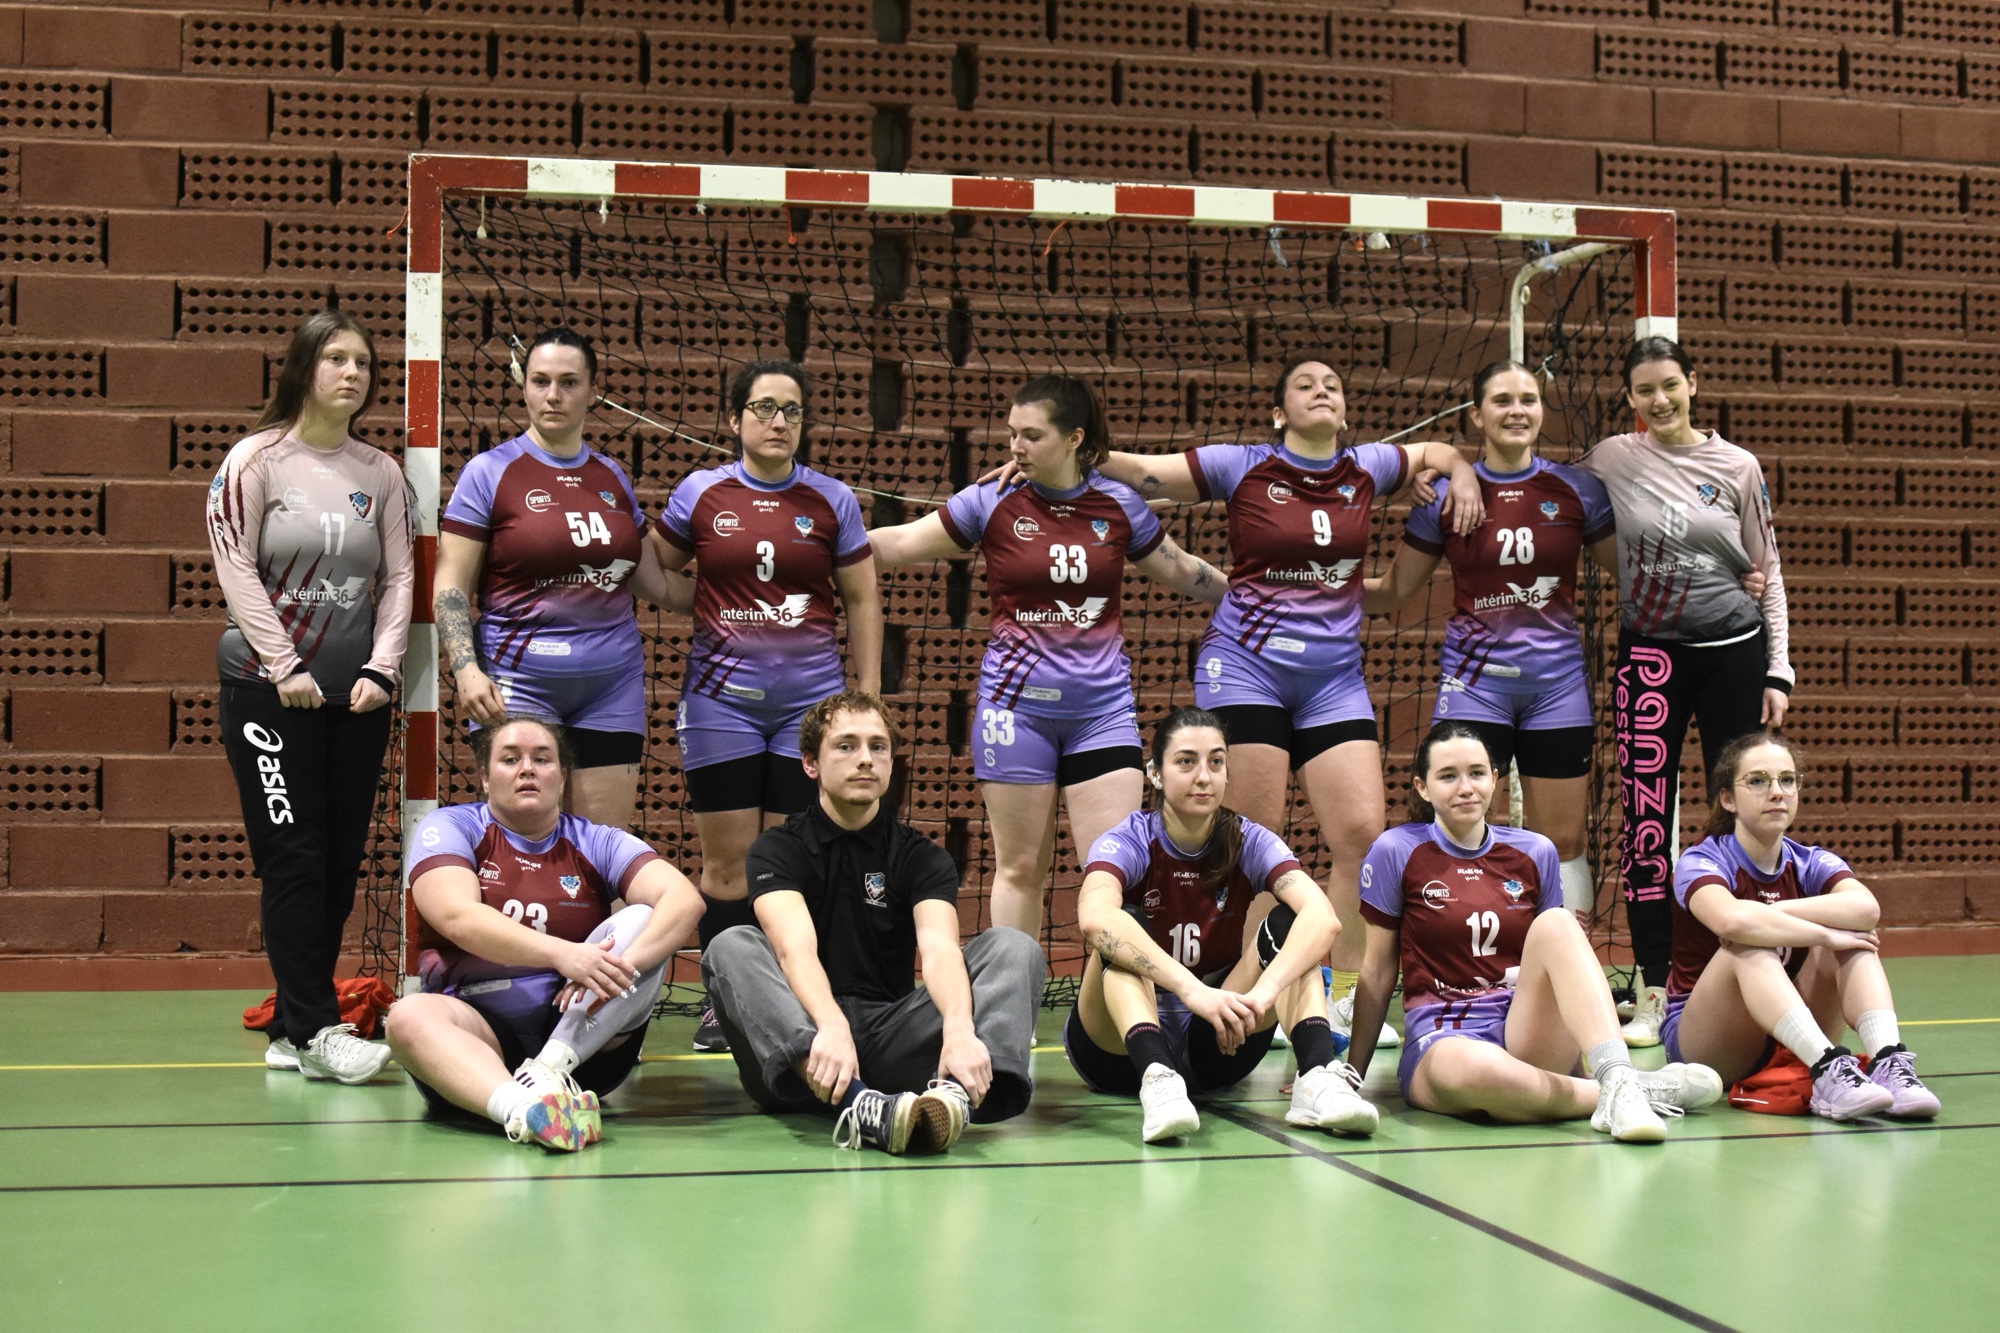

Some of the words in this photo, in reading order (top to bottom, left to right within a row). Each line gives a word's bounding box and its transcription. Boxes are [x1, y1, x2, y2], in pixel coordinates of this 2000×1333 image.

[529, 495, 551, 505] SPORTS
[1271, 486, 1293, 497] SPORTS
[319, 512, 346, 556] 17
[564, 511, 612, 547] 54
[717, 518, 739, 527] SPORTS
[1017, 523, 1039, 532] SPORTS
[1311, 509, 1332, 547] 9
[756, 540, 775, 582] 3
[1049, 543, 1088, 584] 33
[1496, 526, 1535, 566] 28
[982, 708, 1016, 746] 33
[1616, 664, 1633, 768] veste
[257, 754, 294, 825] asics
[1425, 888, 1450, 899] SPORTS
[1168, 922, 1201, 968] 16
[1466, 910, 1500, 958] 12
